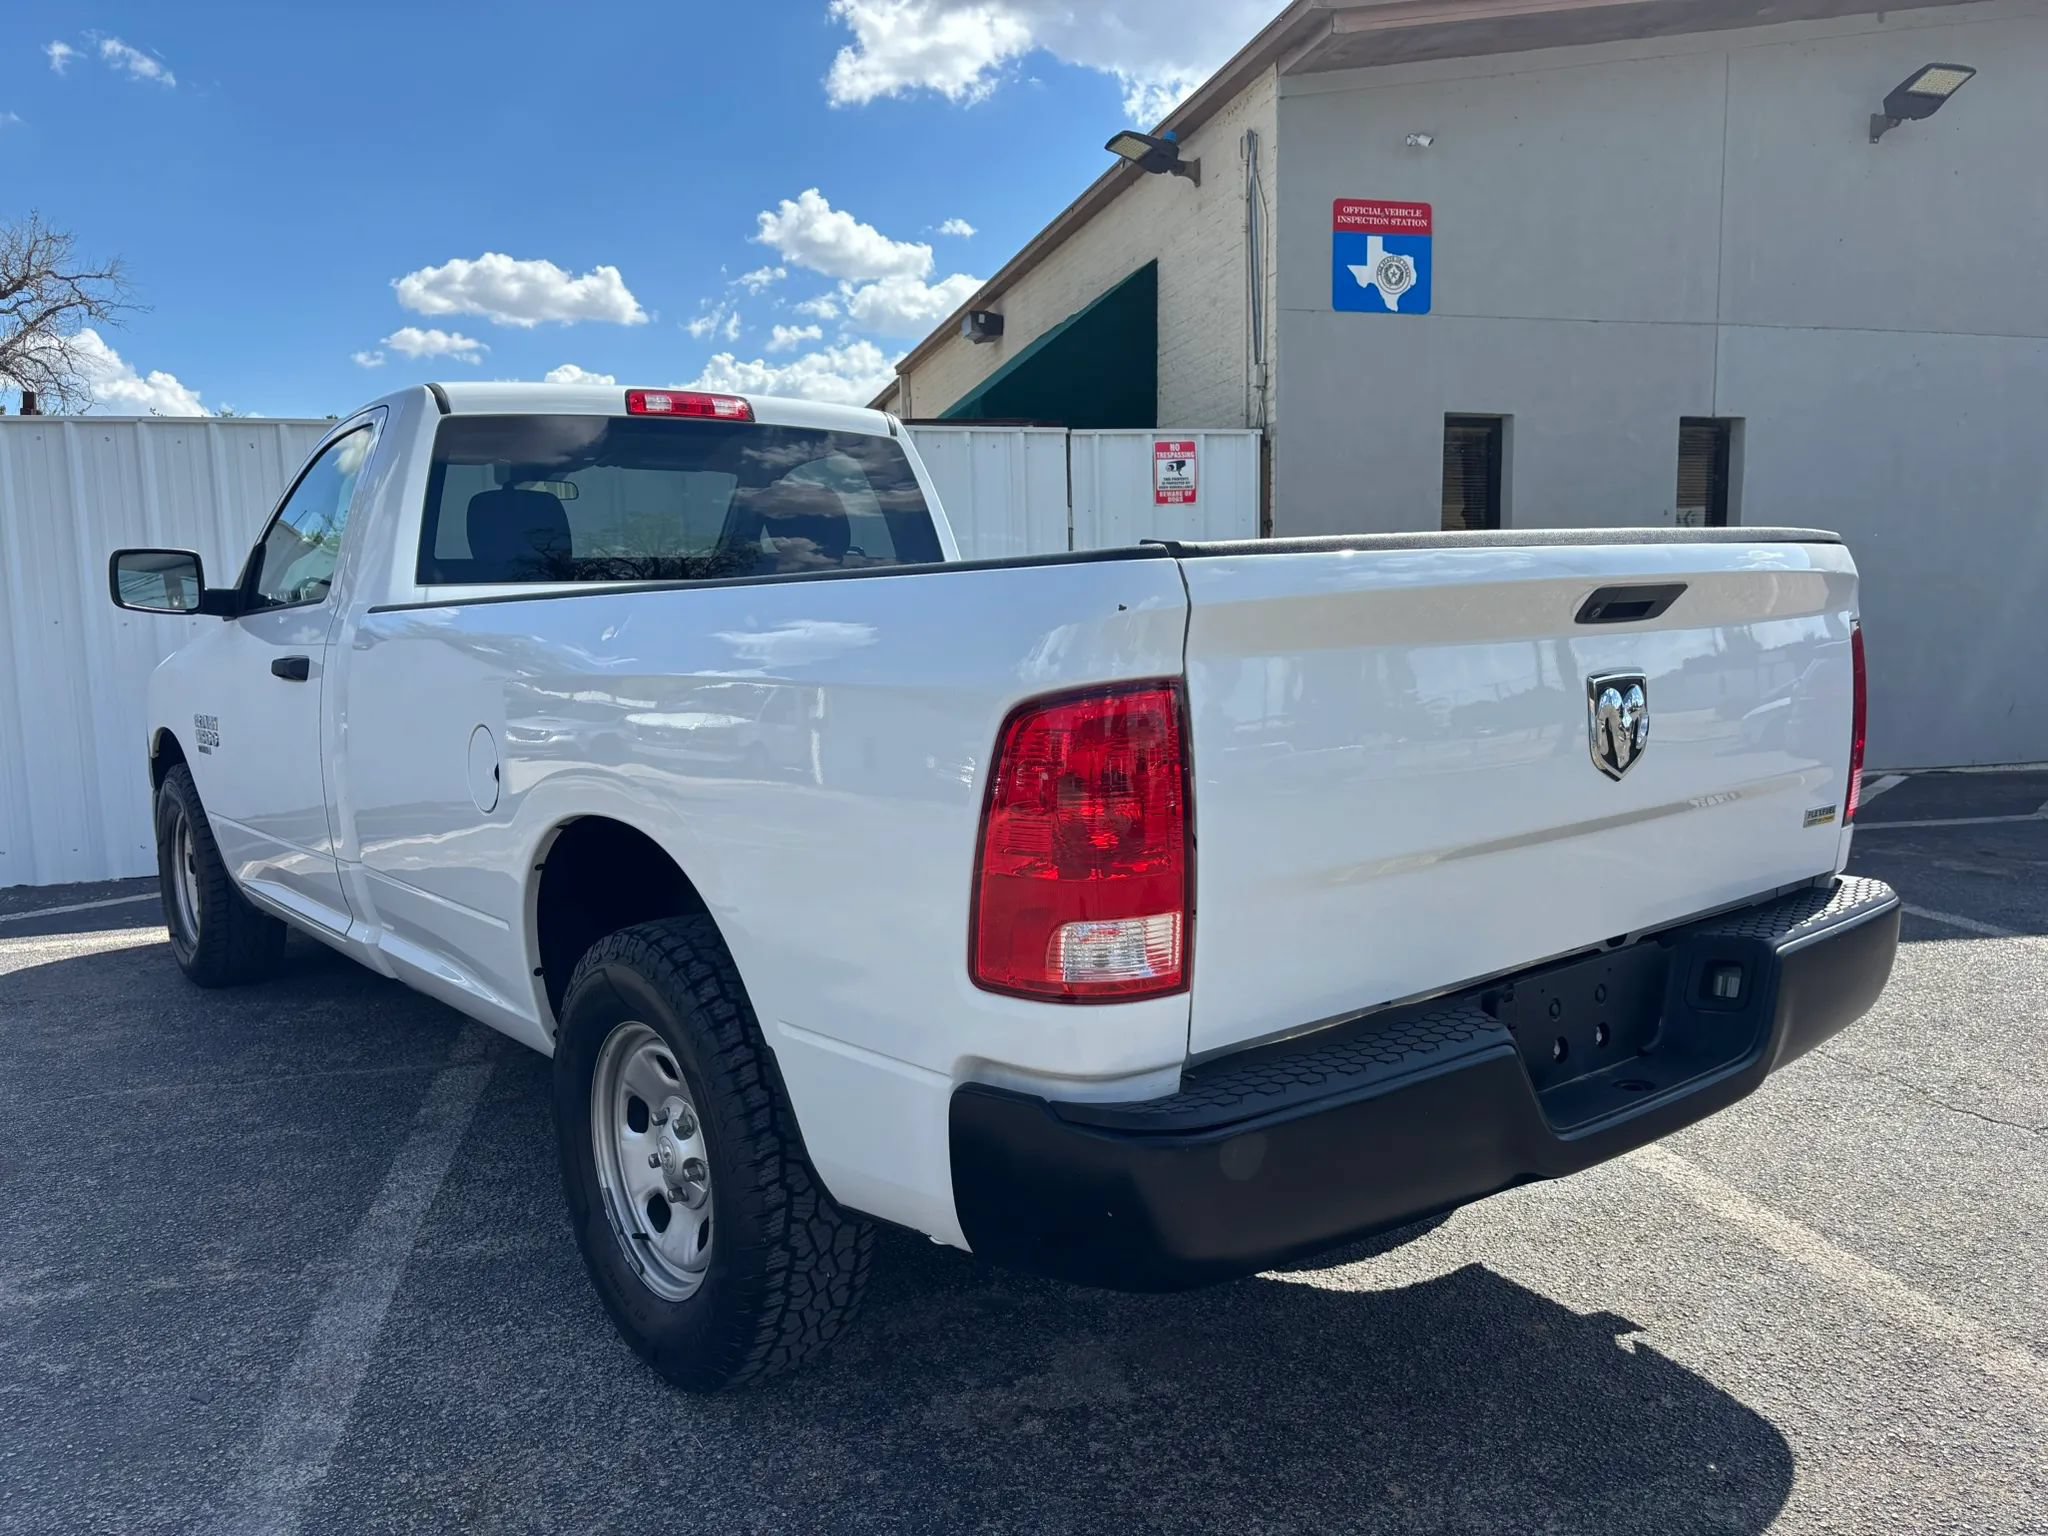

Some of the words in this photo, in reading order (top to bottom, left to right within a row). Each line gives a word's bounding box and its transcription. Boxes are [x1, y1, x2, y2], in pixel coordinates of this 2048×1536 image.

[1343, 206, 1384, 215] OFFICIAL
[1385, 208, 1422, 217] VEHICLE
[1337, 216, 1389, 225] INSPECTION
[1391, 218, 1427, 227] STATION
